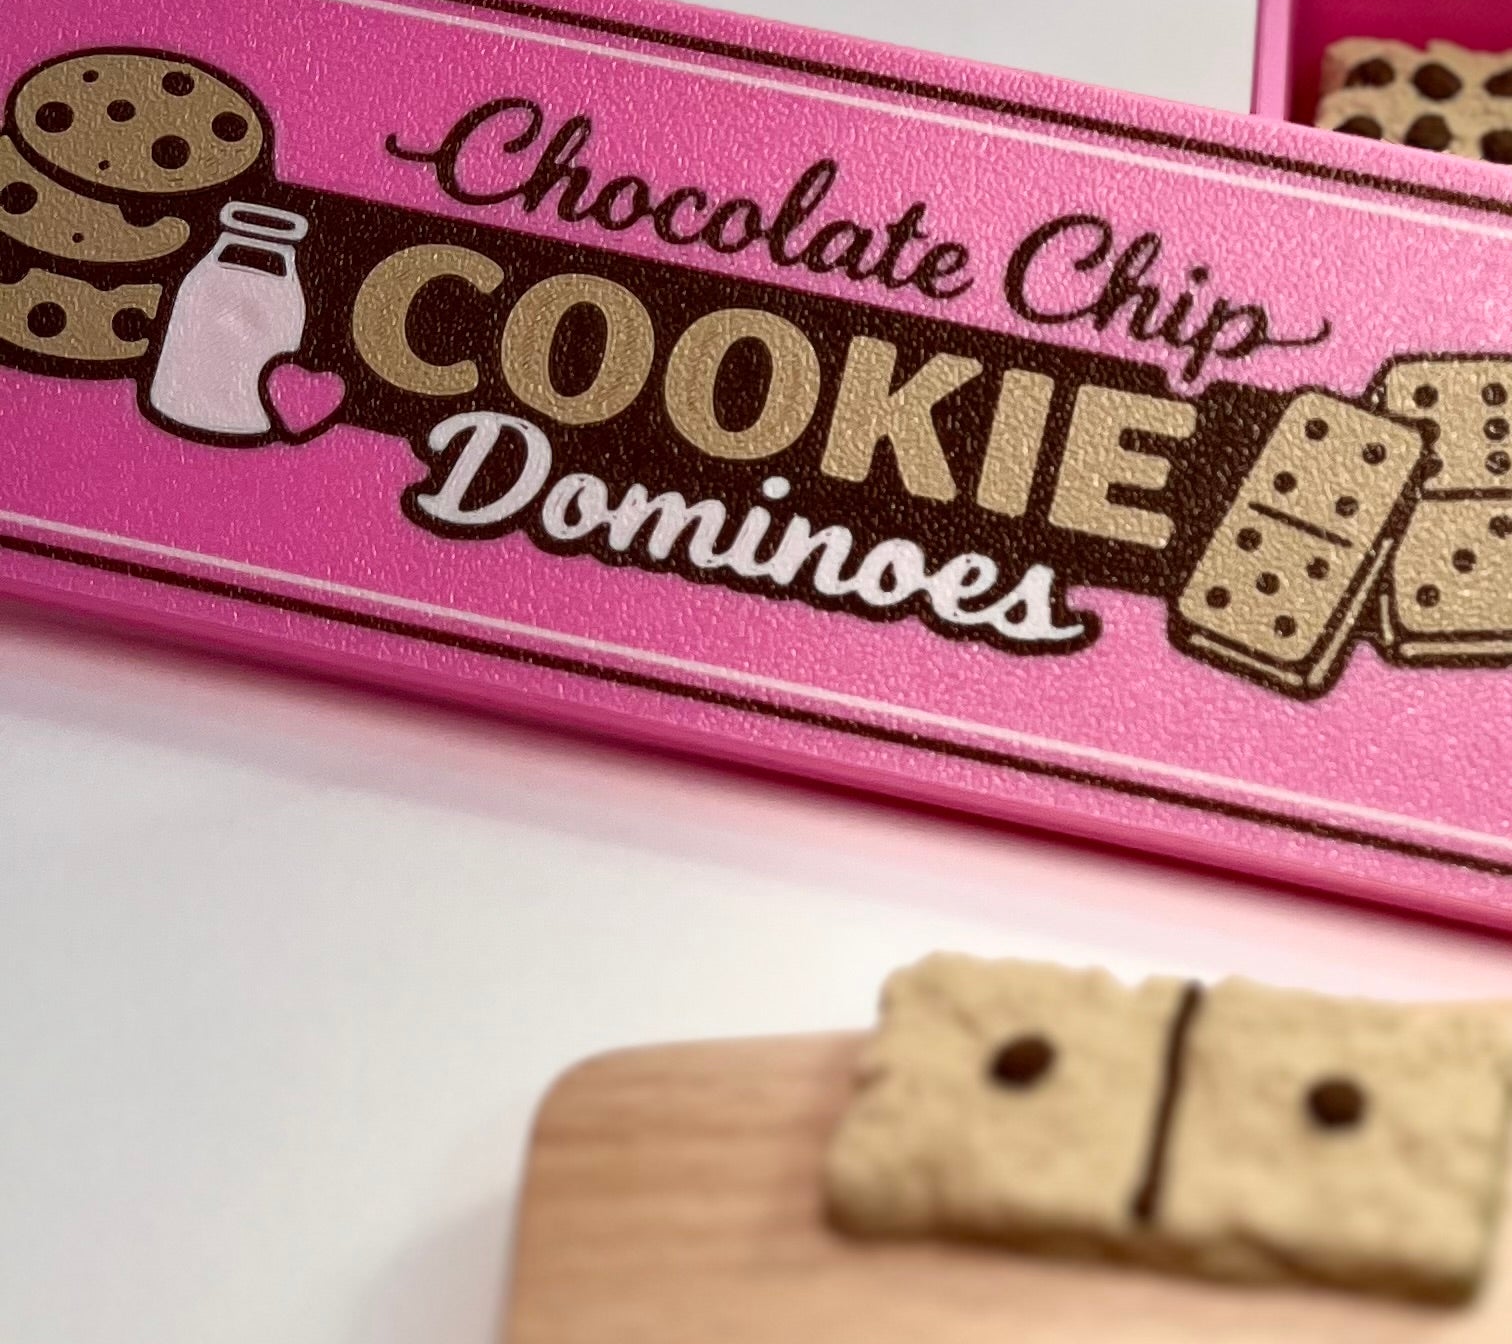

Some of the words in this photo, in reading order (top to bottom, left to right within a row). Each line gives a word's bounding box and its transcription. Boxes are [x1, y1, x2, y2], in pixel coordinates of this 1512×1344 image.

[386, 97, 975, 301] Chocolate
[1004, 214, 1330, 381] Chip
[352, 243, 1198, 549] COOKIE
[416, 411, 1084, 641] Dominoes
